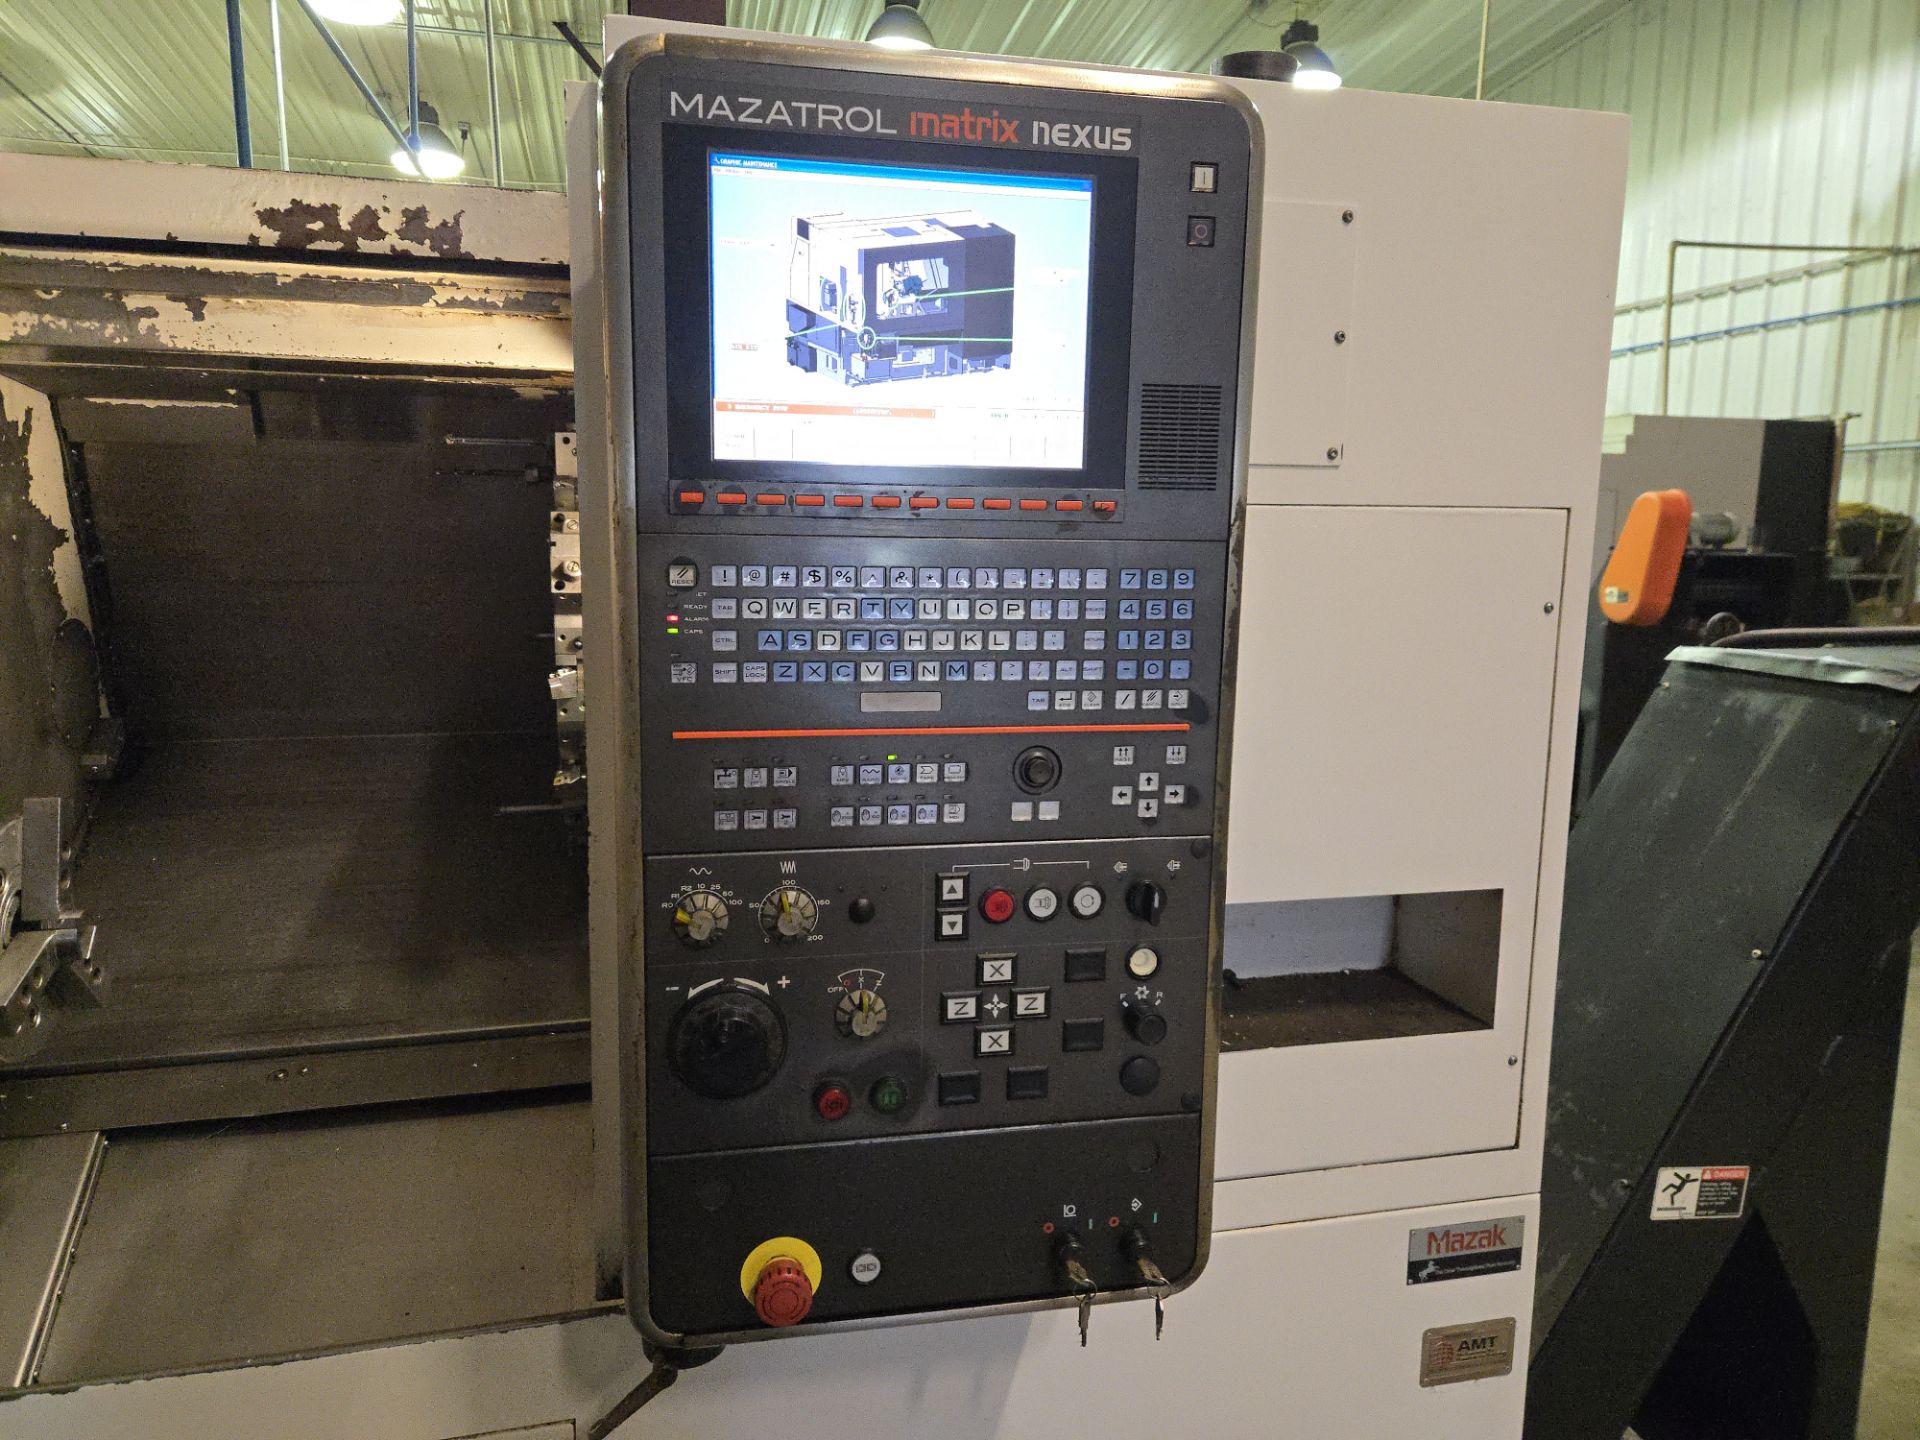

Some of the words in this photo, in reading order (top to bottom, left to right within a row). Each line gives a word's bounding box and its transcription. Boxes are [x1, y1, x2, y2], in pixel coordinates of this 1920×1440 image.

[670, 91, 897, 134] MAZATROL
[1124, 574, 1136, 584] 7
[1152, 574, 1162, 585] 8
[1178, 574, 1189, 585] 9
[748, 601, 763, 614] Q
[776, 601, 794, 614] W
[808, 603, 821, 615] E
[837, 604, 850, 615] R
[867, 603, 879, 612] T
[896, 603, 908, 612] Y
[923, 603, 937, 615] U
[979, 604, 993, 615] O
[1007, 604, 1020, 615] P
[1123, 604, 1135, 614] 4
[1151, 605, 1162, 615] 5
[1177, 604, 1188, 614] 6
[763, 634, 778, 646] A
[793, 634, 807, 646] S
[822, 634, 836, 646] D
[852, 634, 865, 645] F
[880, 634, 894, 645] G
[909, 635, 922, 645] H
[939, 634, 949, 645] J
[965, 634, 977, 645] K
[994, 635, 1004, 645] L
[1126, 634, 1130, 644] 1
[1149, 634, 1160, 645] 2
[1176, 634, 1186, 644] 3
[779, 666, 793, 678] Z
[808, 666, 822, 678] X
[836, 666, 850, 677] C
[865, 666, 880, 676] V
[894, 666, 907, 676] B
[922, 666, 936, 677] N
[949, 665, 964, 675] M
[1148, 664, 1159, 675] 0
[990, 963, 1005, 977] X
[954, 1002, 969, 1015] Z
[1024, 997, 1038, 1011] Z
[988, 1034, 1003, 1048] X
[1427, 1223, 1506, 1255] Mazak
[1458, 1335, 1498, 1351] AMT
